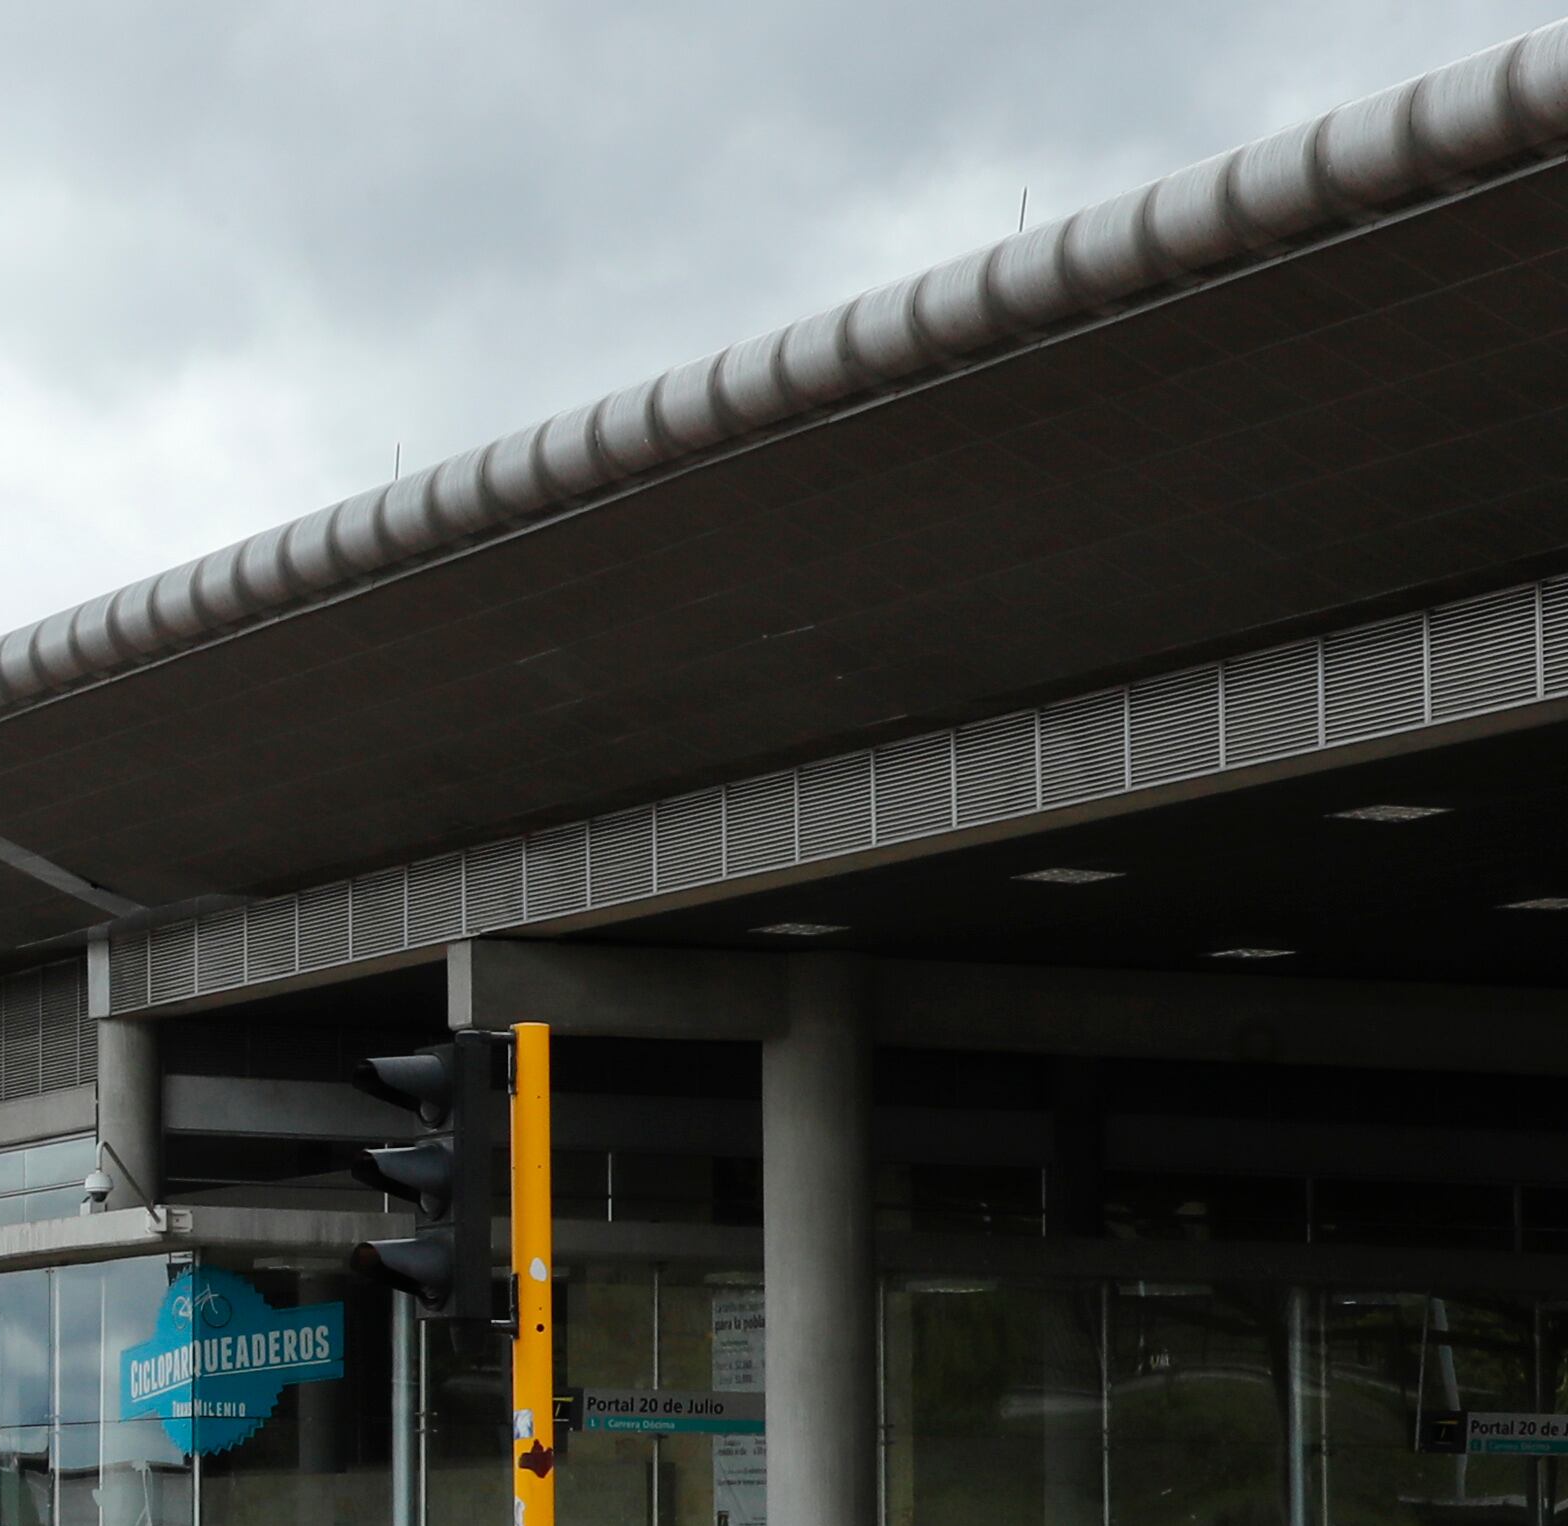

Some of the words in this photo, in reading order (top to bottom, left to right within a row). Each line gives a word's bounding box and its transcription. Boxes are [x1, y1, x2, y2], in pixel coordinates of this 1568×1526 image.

[586, 1397, 634, 1413] Portal
[639, 1398, 658, 1413] 20
[663, 1398, 682, 1414] de
[687, 1399, 724, 1415] Julio
[1471, 1420, 1515, 1436] Portal
[1518, 1422, 1537, 1436] 20
[1541, 1422, 1560, 1437] de
